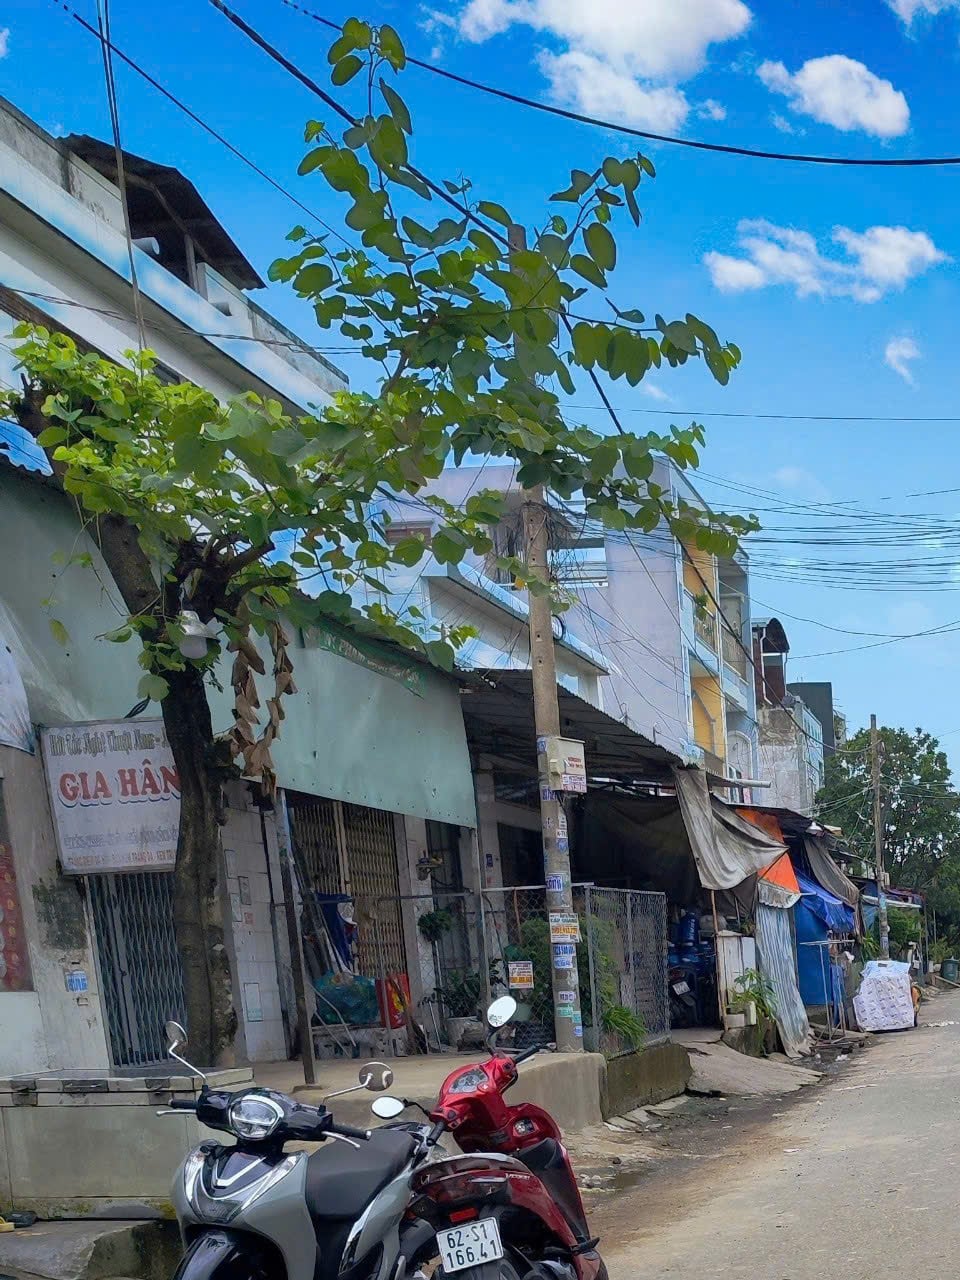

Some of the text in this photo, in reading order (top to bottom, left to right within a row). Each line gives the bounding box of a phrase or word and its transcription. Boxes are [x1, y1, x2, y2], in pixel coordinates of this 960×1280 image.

[59, 758, 181, 802] GIA HÂN
[446, 1223, 488, 1249] 62-S1
[447, 1240, 498, 1268] 166.41
